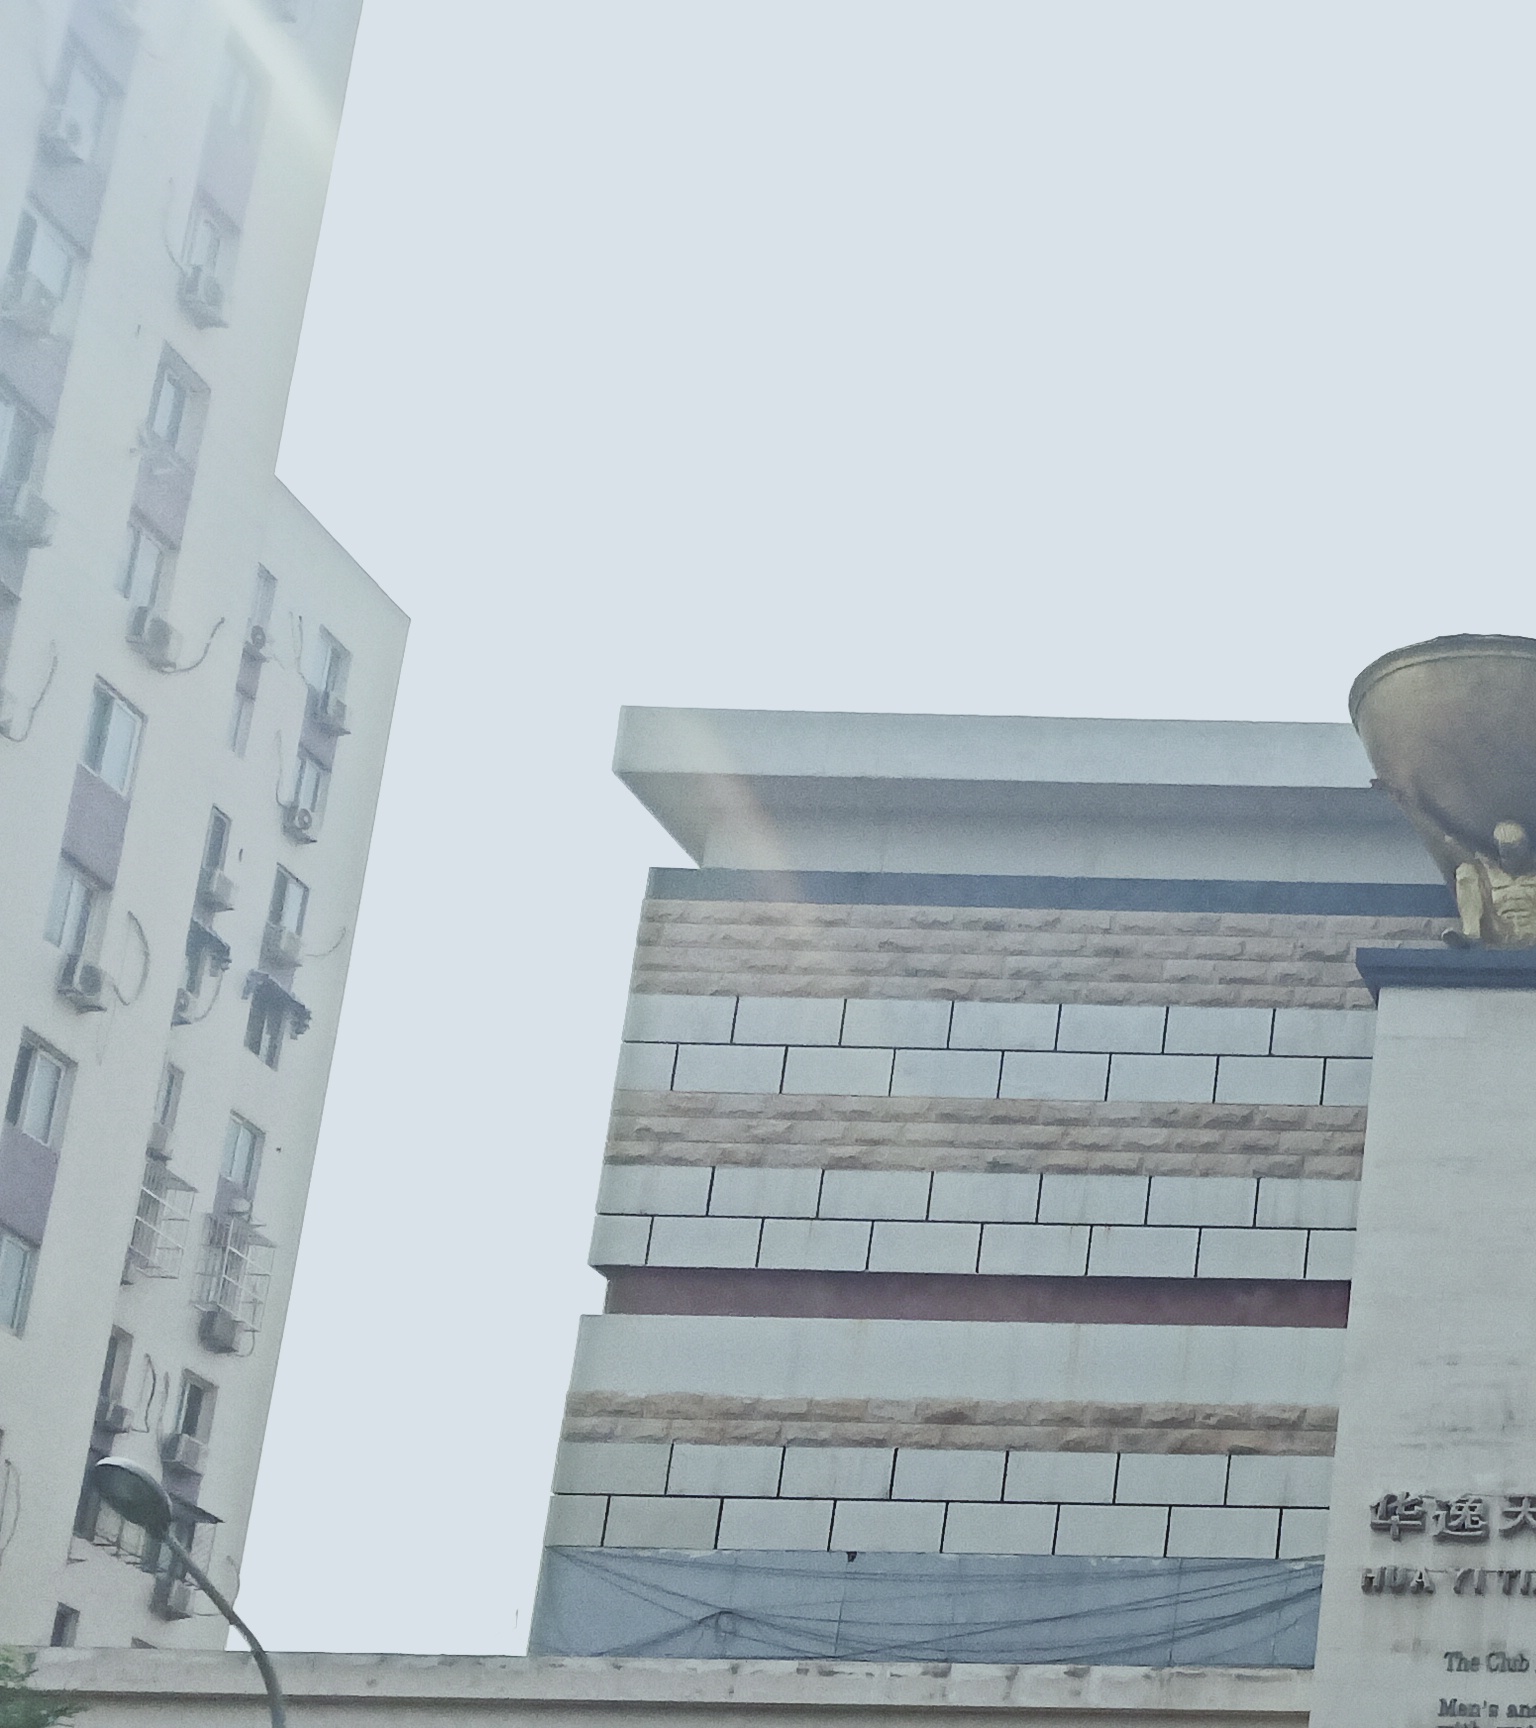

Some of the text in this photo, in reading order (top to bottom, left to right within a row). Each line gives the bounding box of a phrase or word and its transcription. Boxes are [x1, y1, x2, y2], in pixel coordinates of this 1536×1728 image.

[1362, 1567, 1434, 1595] HUA
[1453, 1568, 1486, 1596] YI
[1444, 1651, 1480, 1672] The
[1486, 1651, 1529, 1673] Club
[1437, 1698, 1499, 1717] Men's
